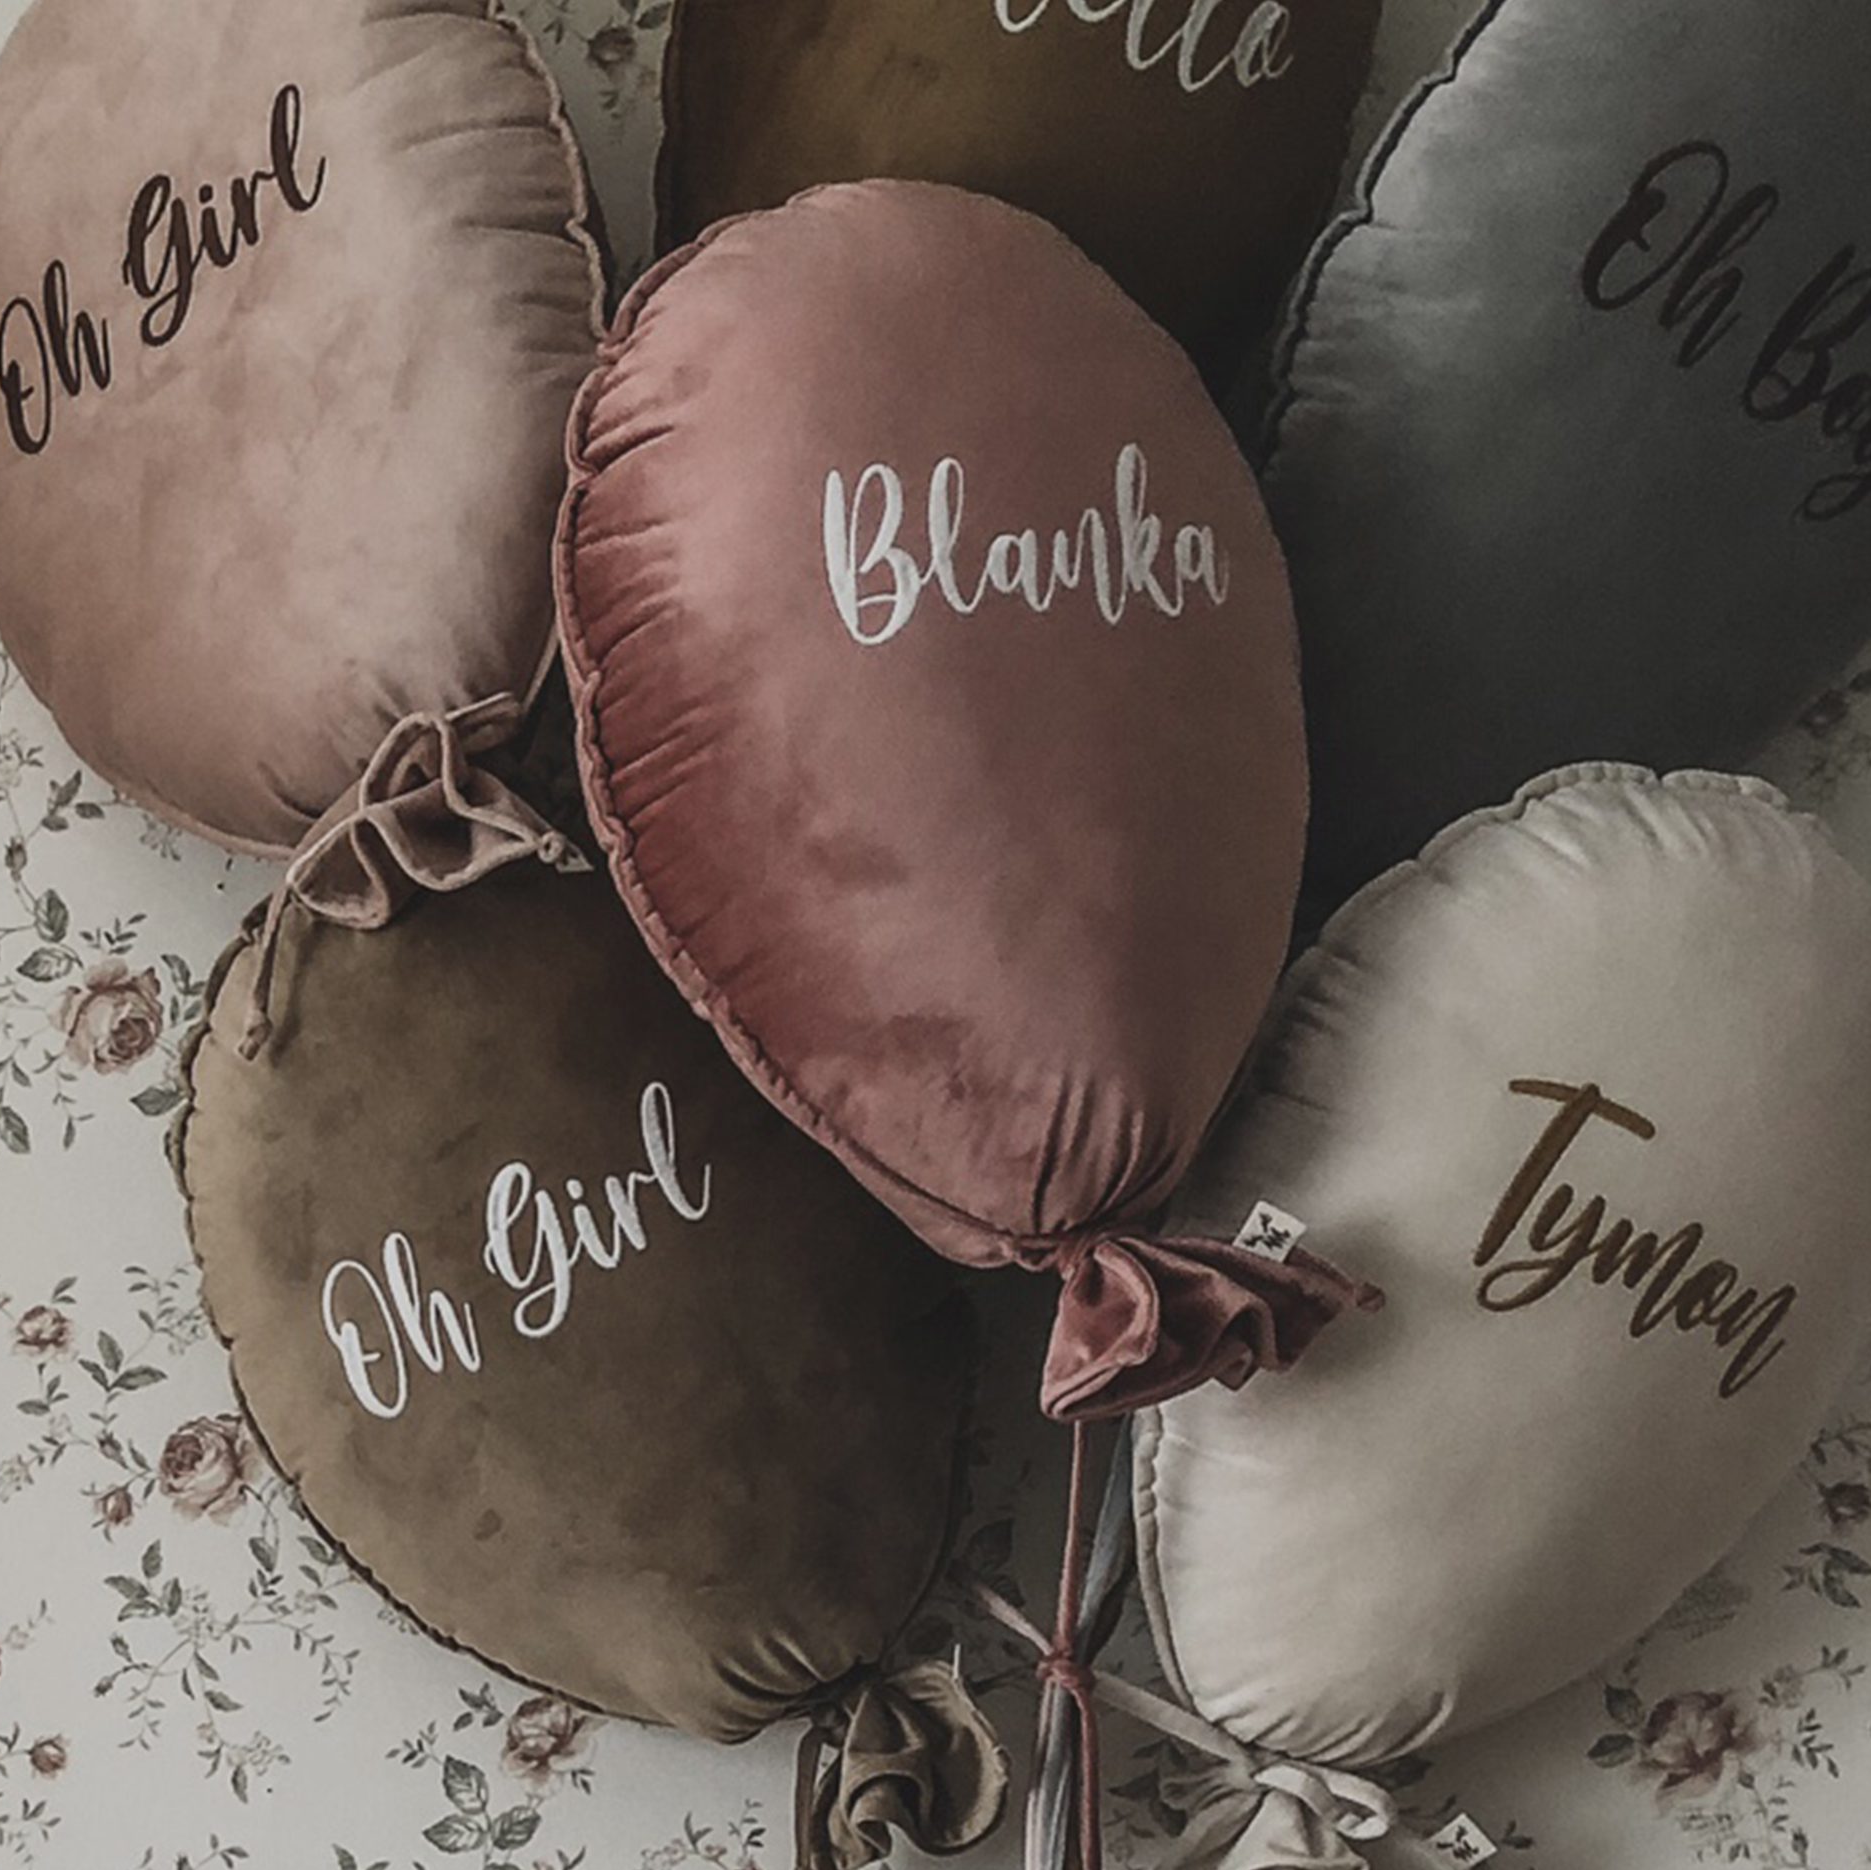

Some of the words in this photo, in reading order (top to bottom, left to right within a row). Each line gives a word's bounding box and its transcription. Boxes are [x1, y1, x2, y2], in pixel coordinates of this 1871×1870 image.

[122, 84, 325, 347] Girl
[1581, 140, 1779, 368] Oh
[823, 443, 1229, 645] Blanka
[322, 1232, 480, 1418] Oh
[483, 1081, 711, 1337] Girl
[1473, 1079, 1797, 1399] Tymon
